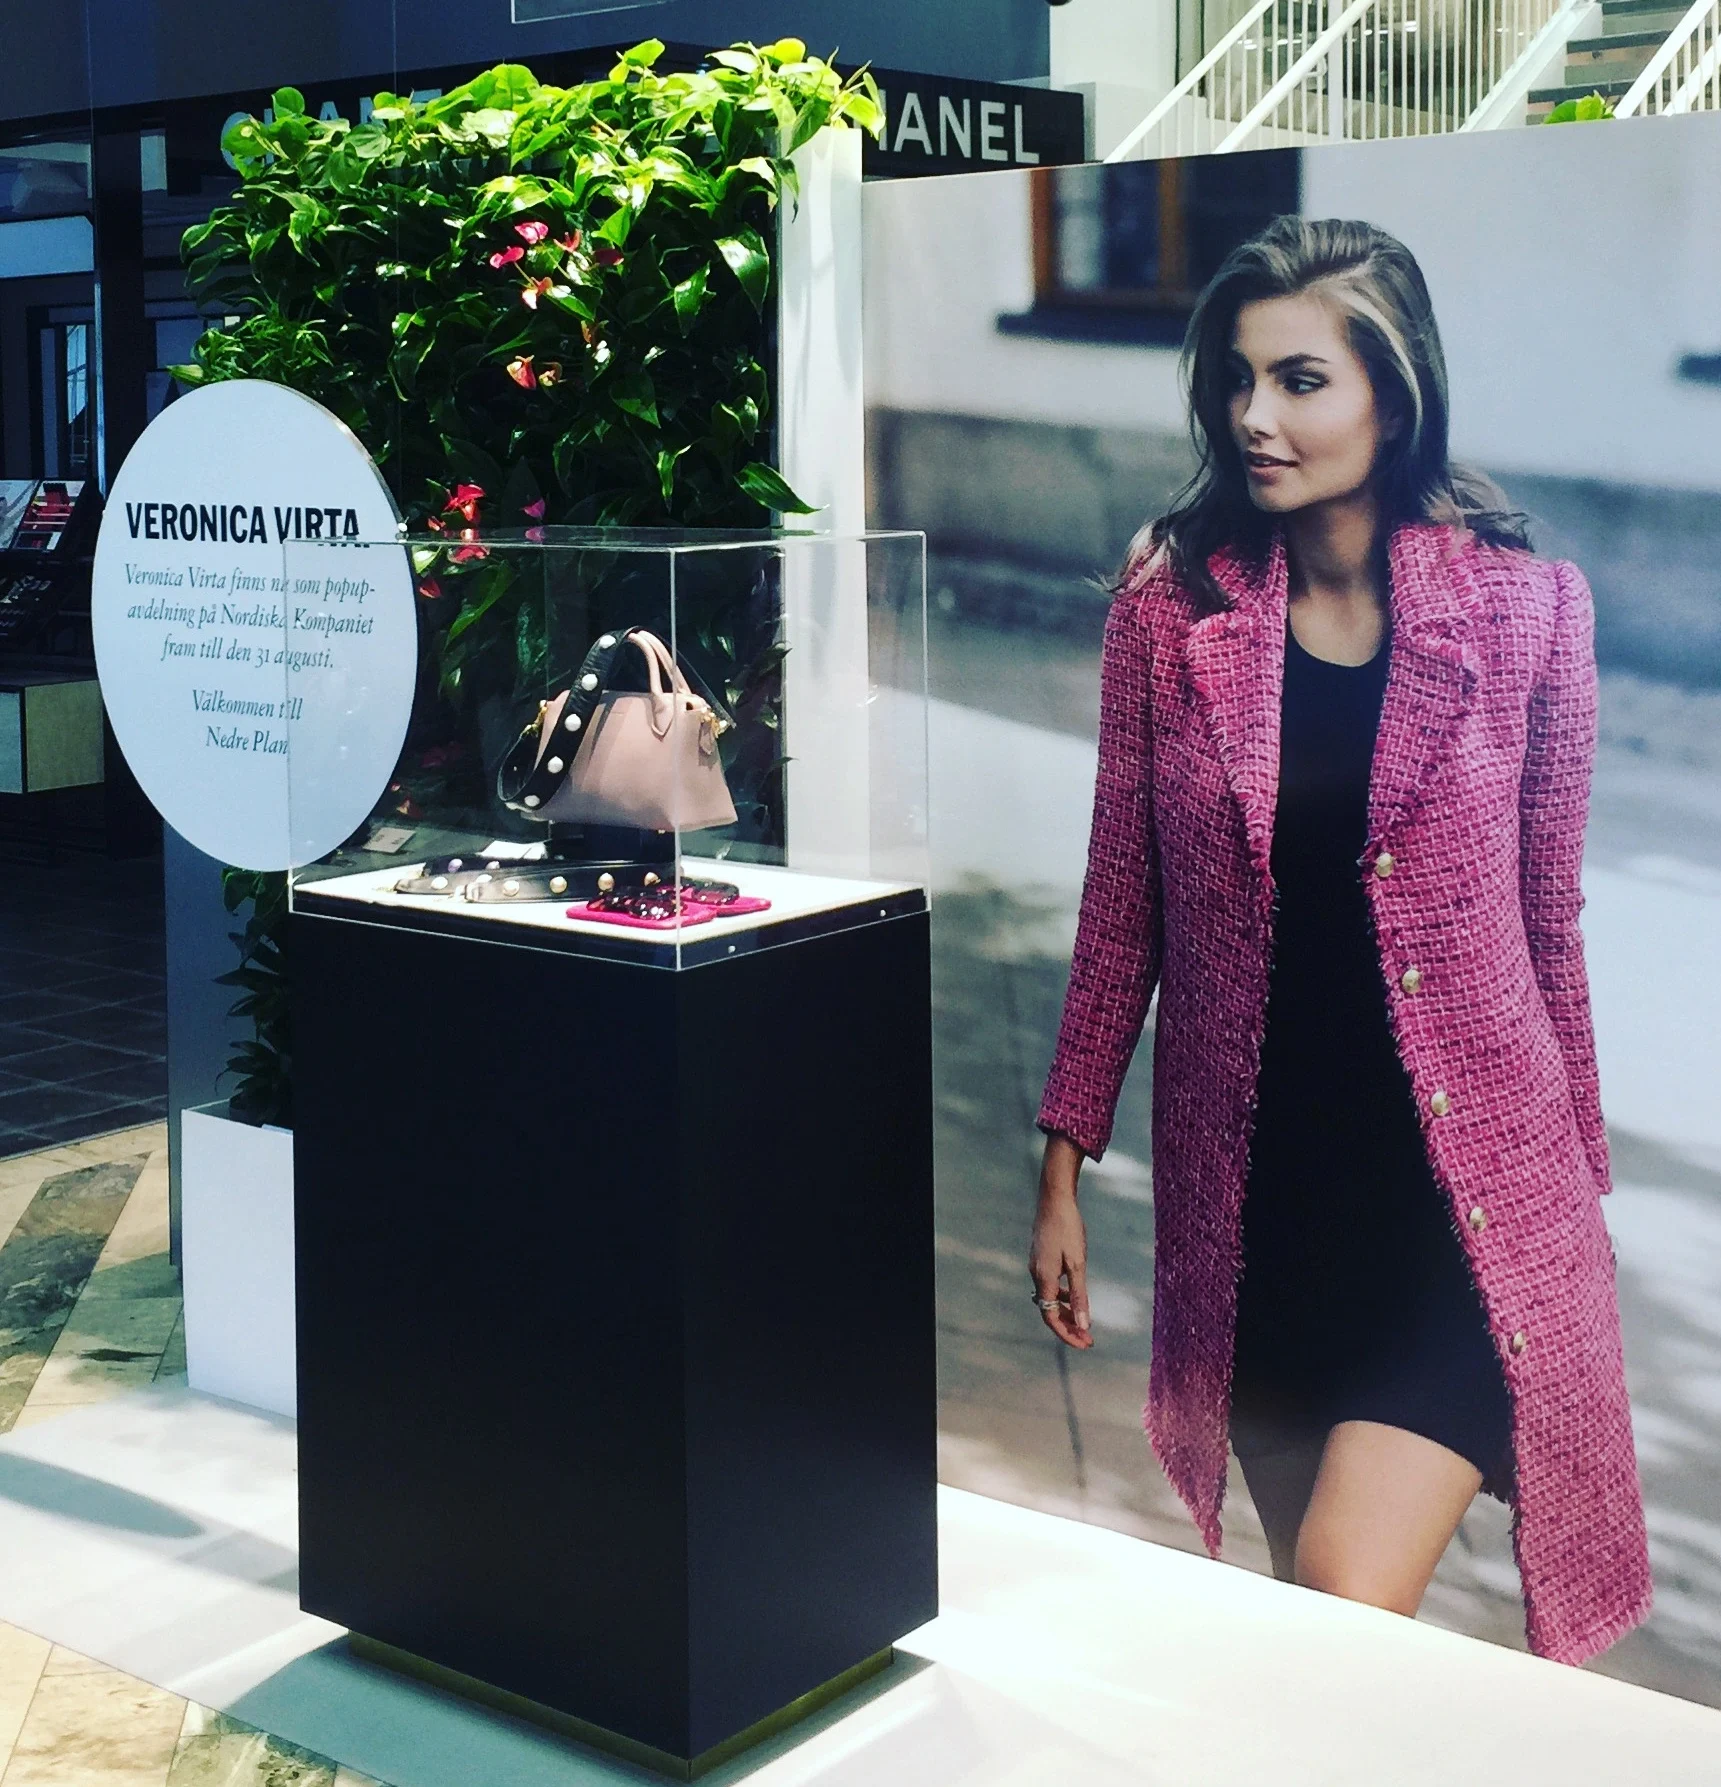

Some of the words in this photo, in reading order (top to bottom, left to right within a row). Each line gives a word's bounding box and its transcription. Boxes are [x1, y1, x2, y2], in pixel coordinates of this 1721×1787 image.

[126, 502, 267, 544] VERONICA
[274, 506, 360, 545] VIRTA
[125, 563, 184, 587] Veronica
[188, 566, 227, 589] Virta
[227, 567, 266, 596] finns
[293, 578, 321, 594] som
[323, 577, 375, 604] popup-
[127, 598, 195, 629] avdelning
[198, 604, 217, 629] på
[220, 603, 287, 628] Nordiska
[293, 607, 374, 638] Kompaniet
[160, 633, 196, 661] fram
[200, 637, 223, 659] till
[226, 638, 251, 662] den
[255, 647, 270, 668] 31
[274, 648, 334, 672] augusti.
[192, 690, 274, 718] Välkommen
[206, 725, 249, 750] Nedre
[252, 730, 288, 754] Plan
